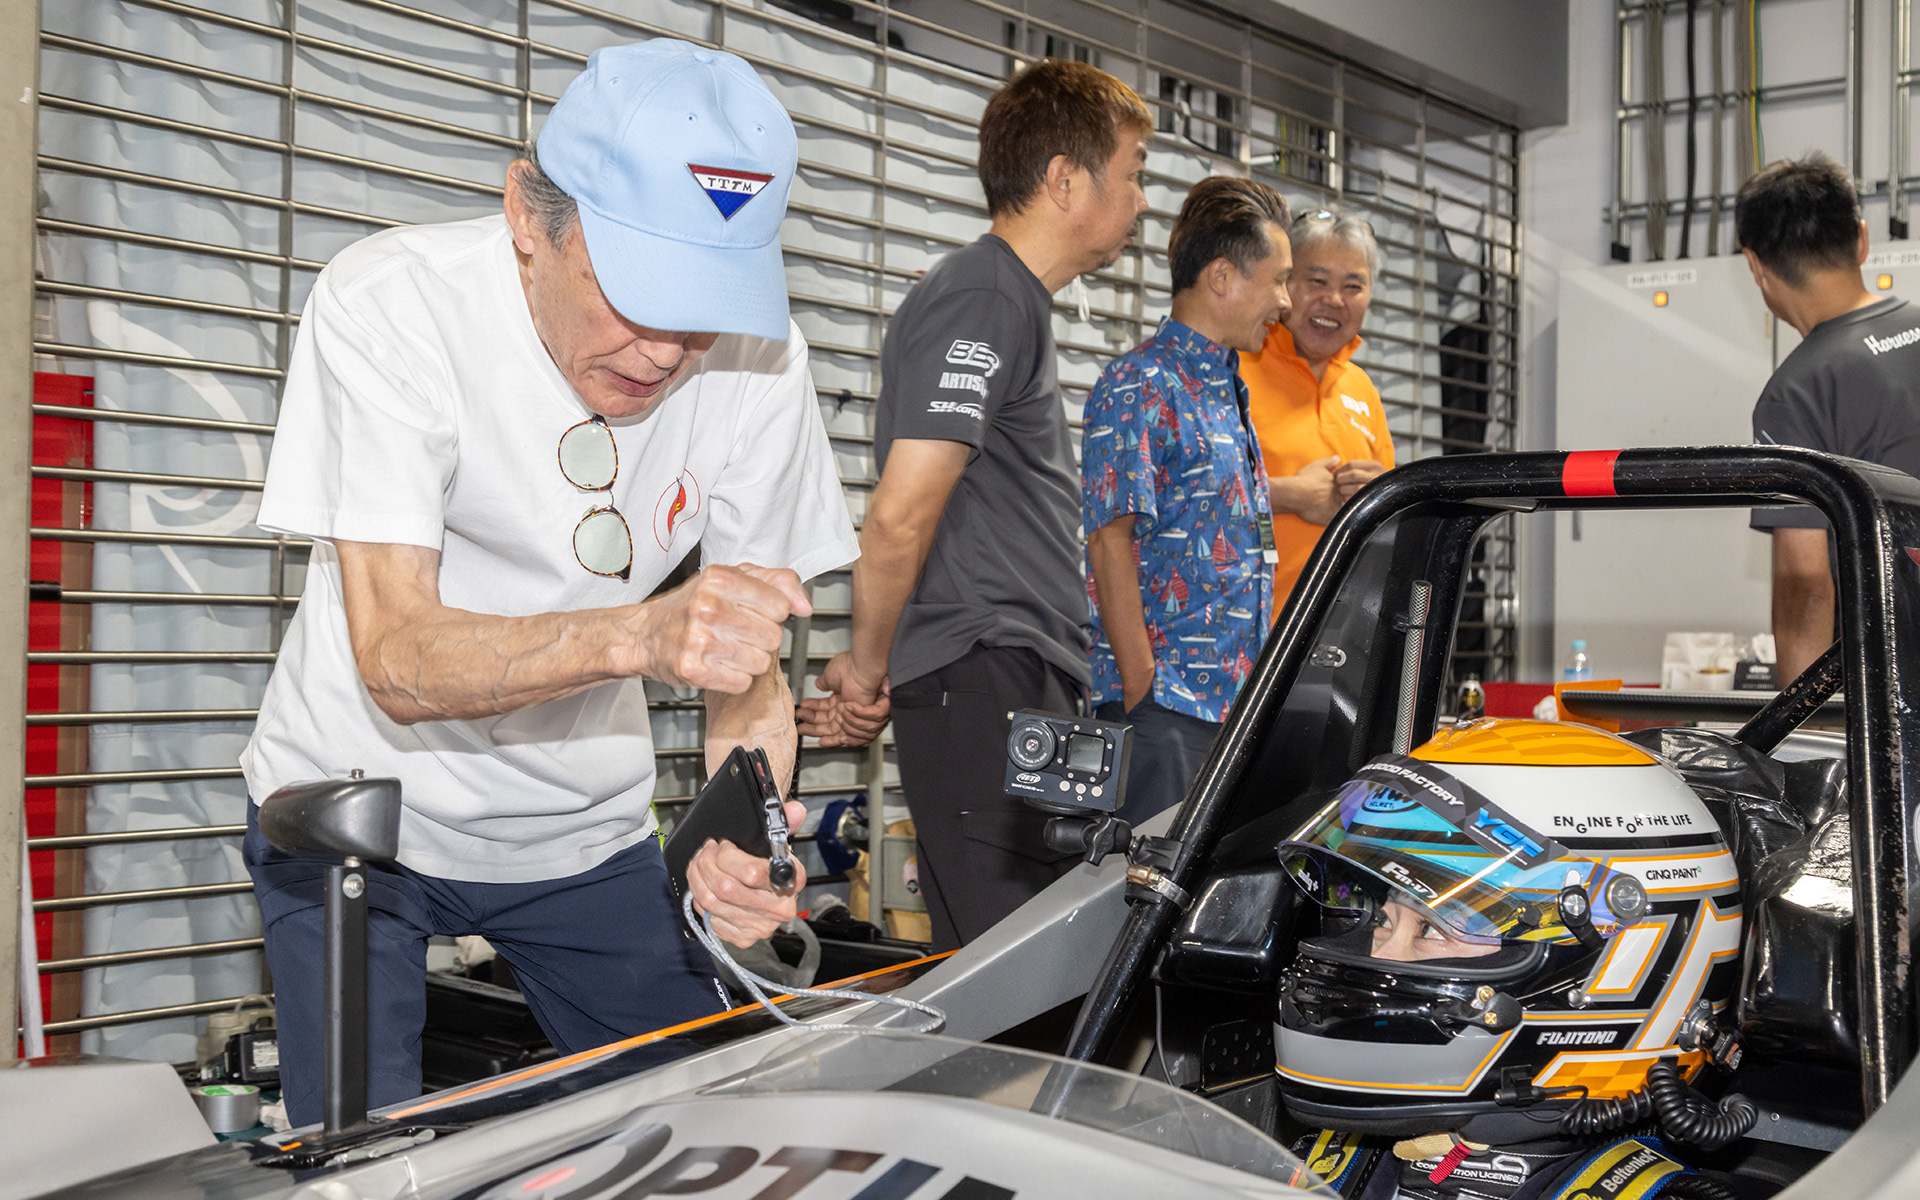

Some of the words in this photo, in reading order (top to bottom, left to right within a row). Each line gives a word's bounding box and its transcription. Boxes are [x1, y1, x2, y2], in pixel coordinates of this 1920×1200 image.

[707, 177, 753, 192] TTTM
[1397, 768, 1465, 806] FACTORY
[1553, 815, 1613, 834] ENGINE
[1616, 815, 1644, 834] FOR
[1646, 815, 1669, 826] THE
[1670, 813, 1693, 826] LIFE
[1536, 1030, 1618, 1045] FUJITOMO
